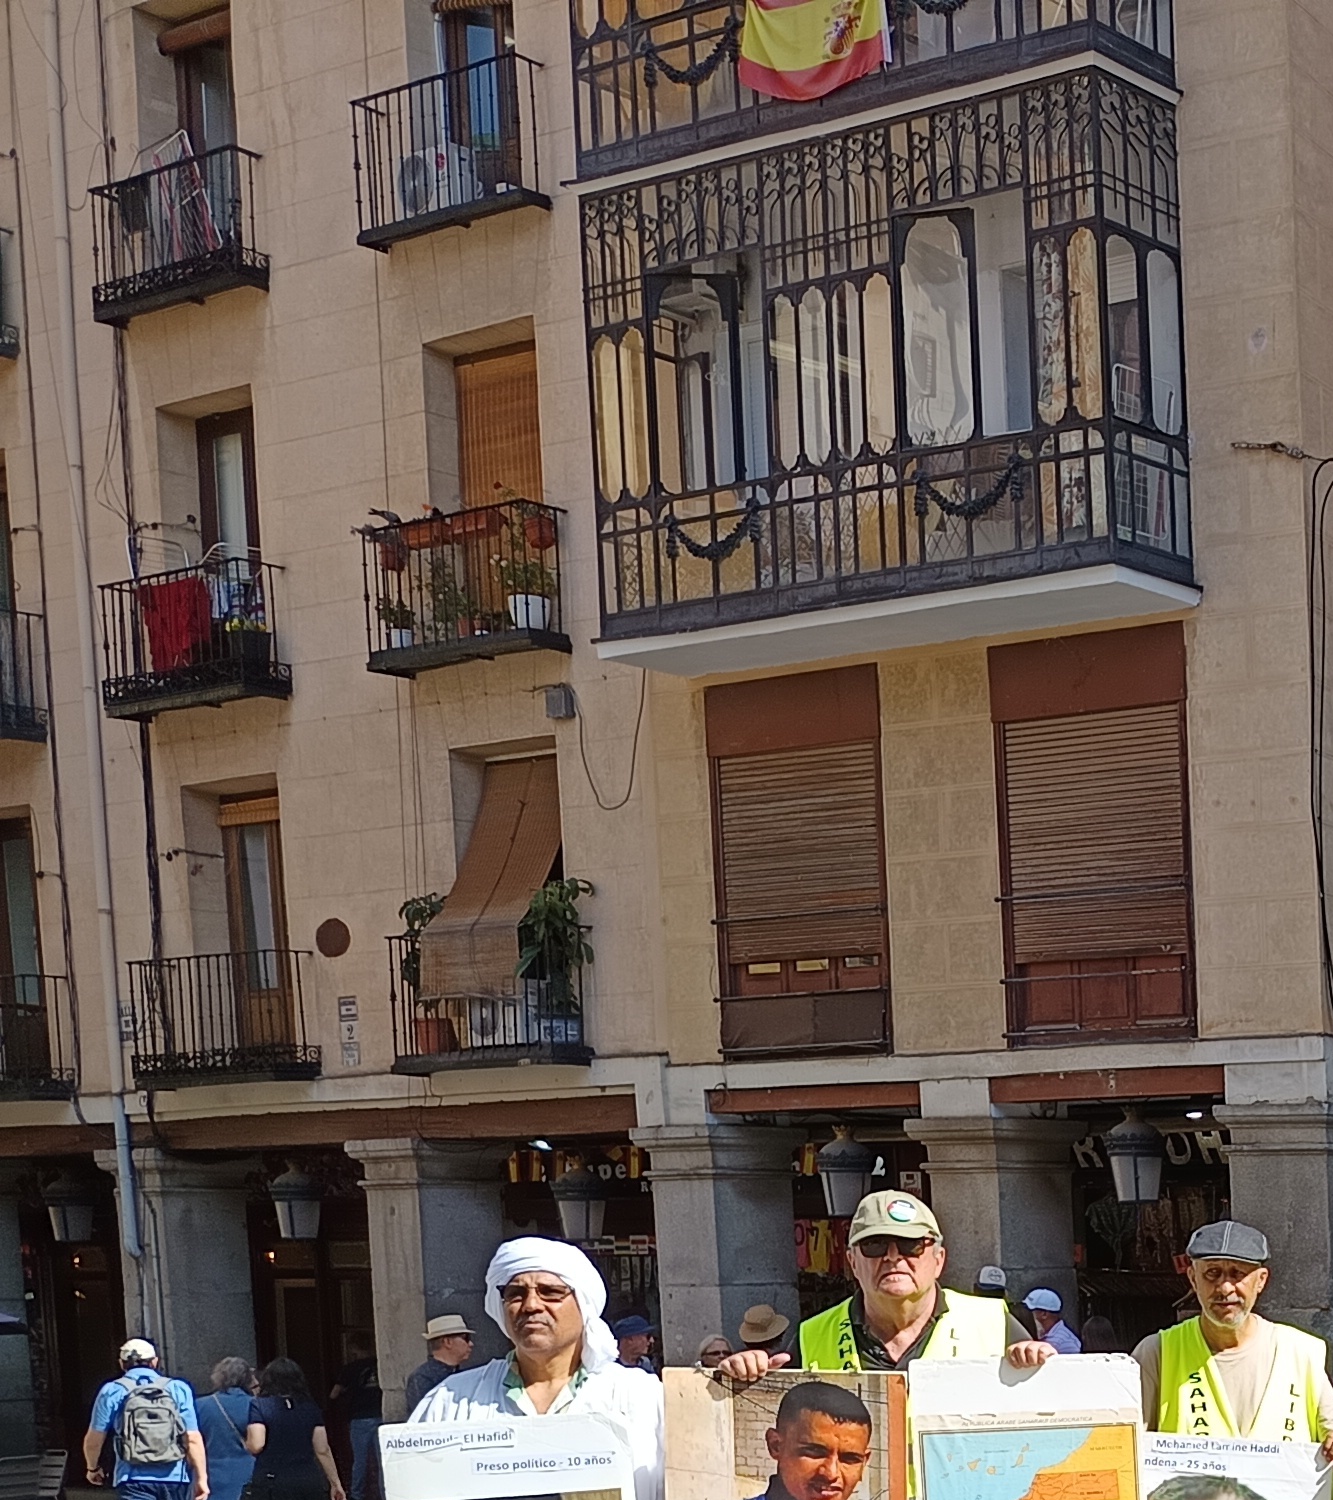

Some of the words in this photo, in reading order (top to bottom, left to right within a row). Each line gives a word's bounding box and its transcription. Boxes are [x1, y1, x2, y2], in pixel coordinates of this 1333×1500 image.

[1188, 1371, 1210, 1436] SAHA
[463, 1434, 474, 1444] El
[477, 1430, 512, 1444] Hafidi
[1156, 1439, 1209, 1451] Mohamed
[1250, 1443, 1280, 1454] Haddi
[476, 1460, 510, 1473] Preso
[512, 1457, 557, 1473] político
[568, 1456, 581, 1467] 10
[584, 1454, 612, 1466] años
[1187, 1460, 1199, 1469] 25
[1202, 1461, 1227, 1471] años
